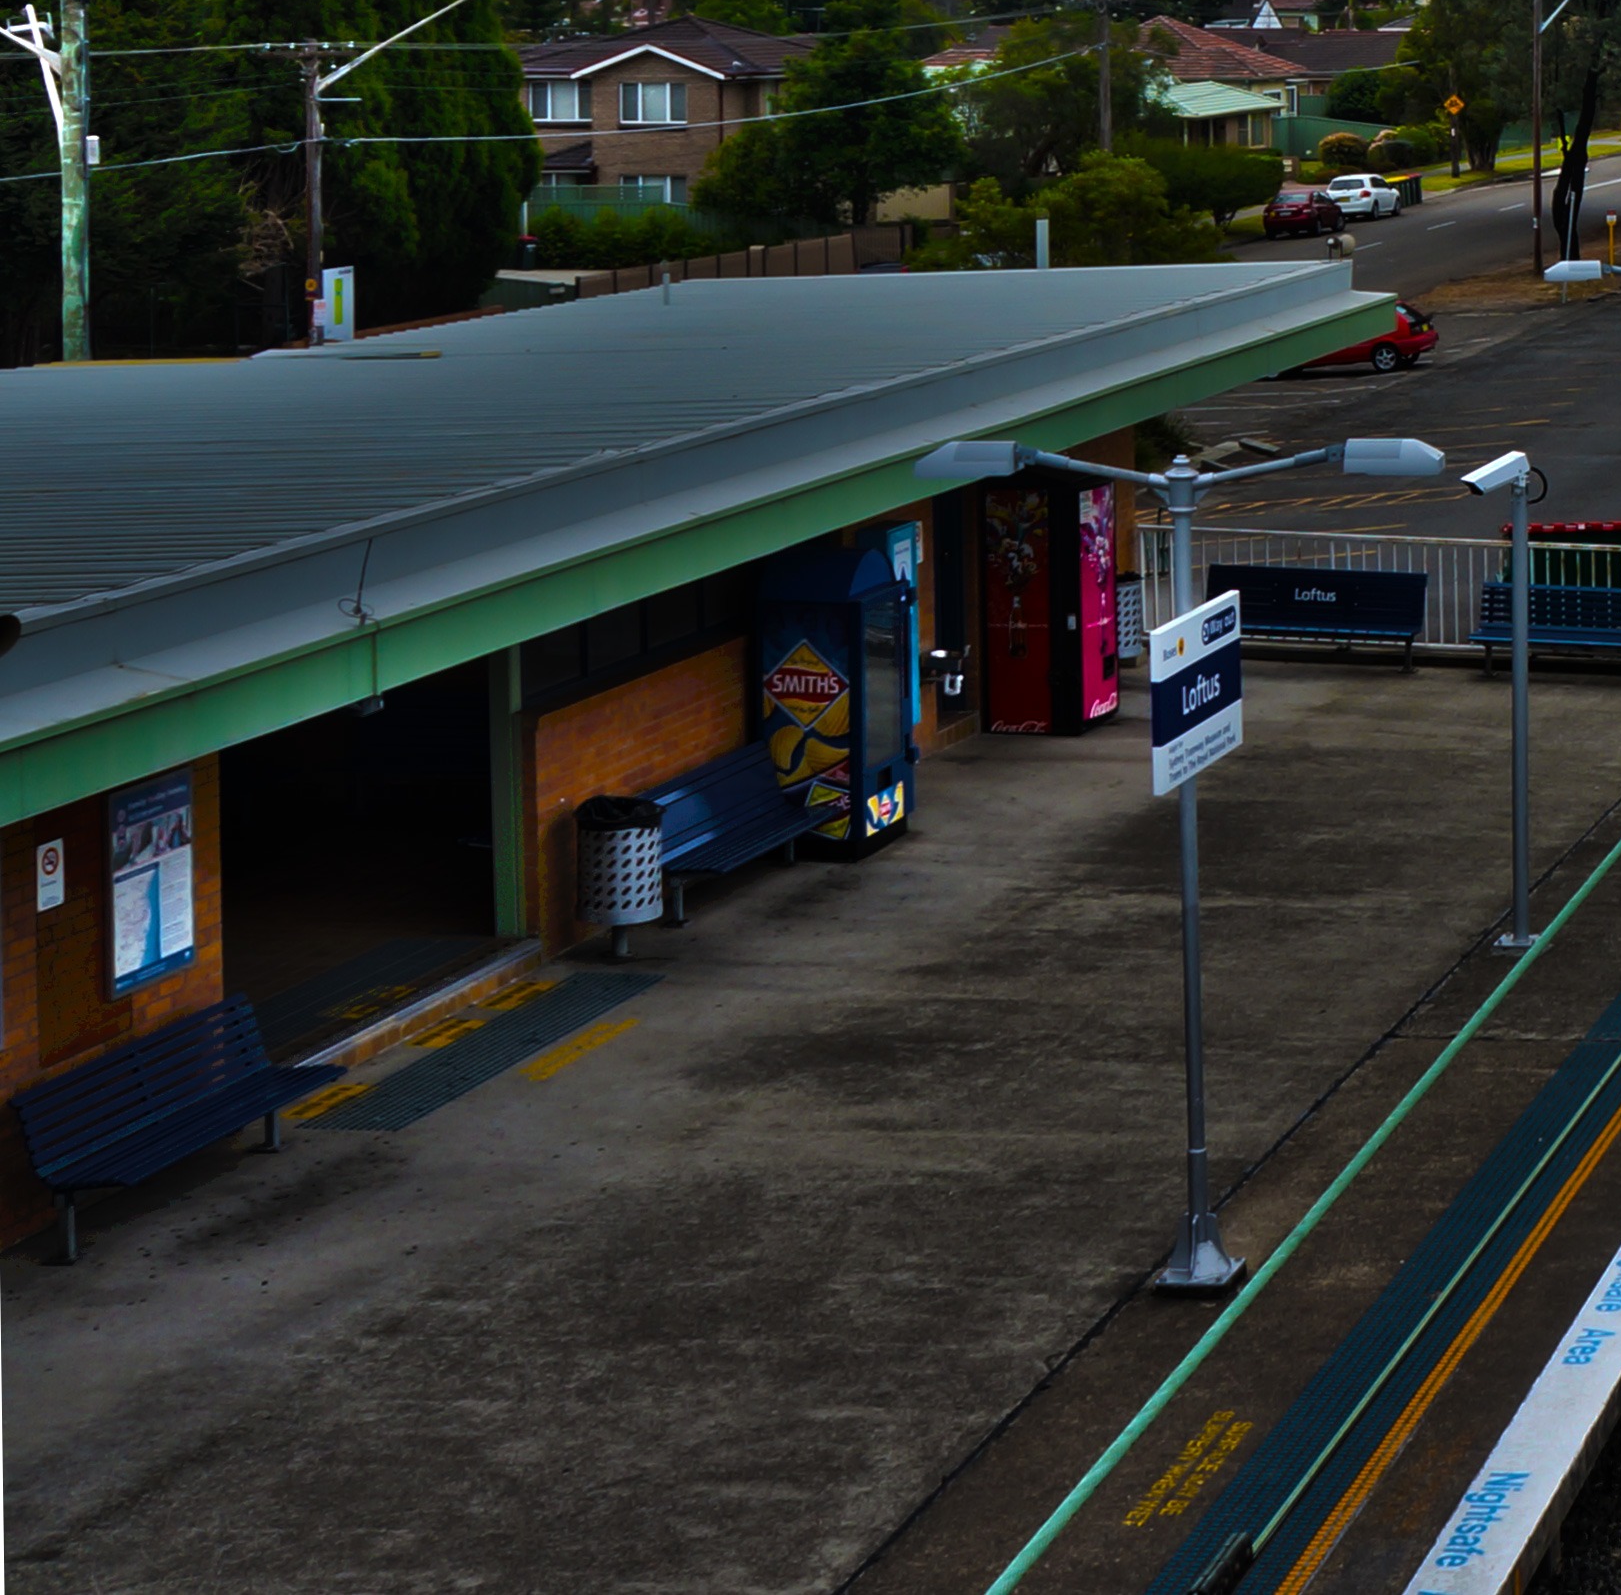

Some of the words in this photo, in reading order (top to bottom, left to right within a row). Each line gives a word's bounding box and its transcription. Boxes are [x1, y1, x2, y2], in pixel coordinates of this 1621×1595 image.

[1294, 587, 1337, 603] Loftus
[1182, 673, 1221, 716] Loftus
[1562, 1328, 1616, 1365] Area
[1435, 1471, 1531, 1568] Nightsafe
